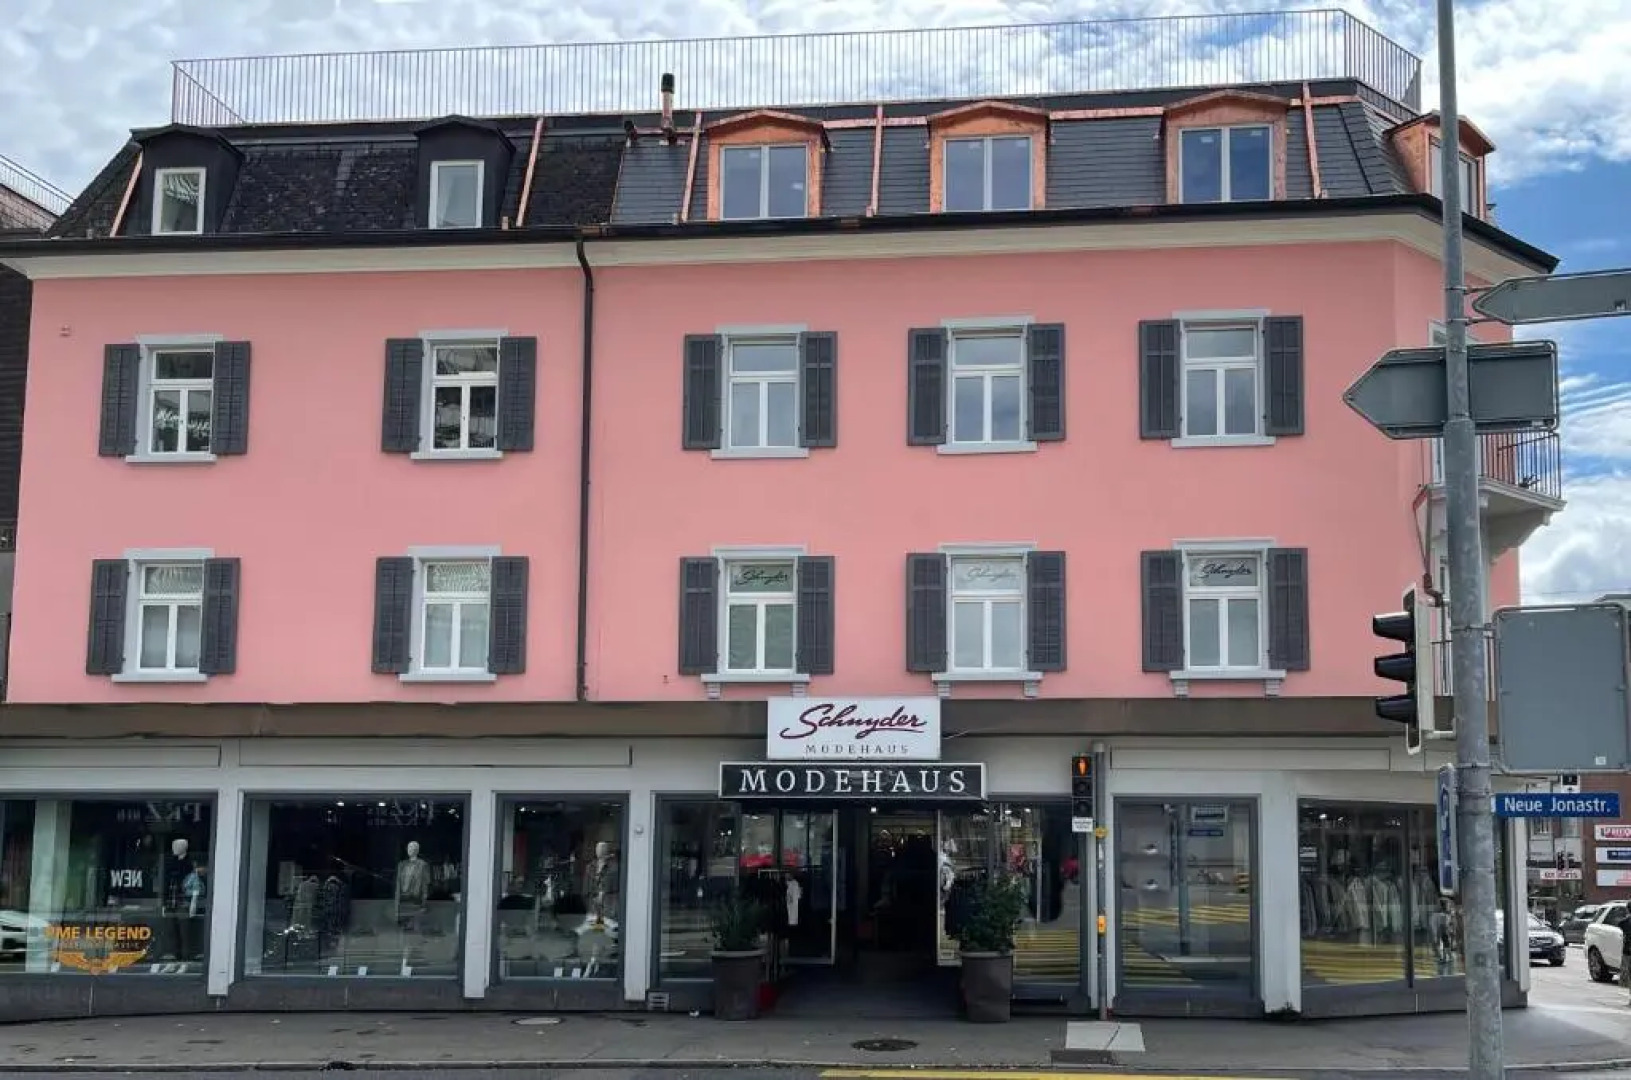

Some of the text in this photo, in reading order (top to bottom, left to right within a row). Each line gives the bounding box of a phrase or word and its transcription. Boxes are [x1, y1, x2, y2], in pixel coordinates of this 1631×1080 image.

[779, 703, 927, 740] Schnyder
[805, 743, 909, 755] MODEHAUS
[739, 769, 966, 793] MODEHAUS
[1504, 797, 1611, 812] Neue Jonastr.
[86, 926, 152, 941] LEGEND
